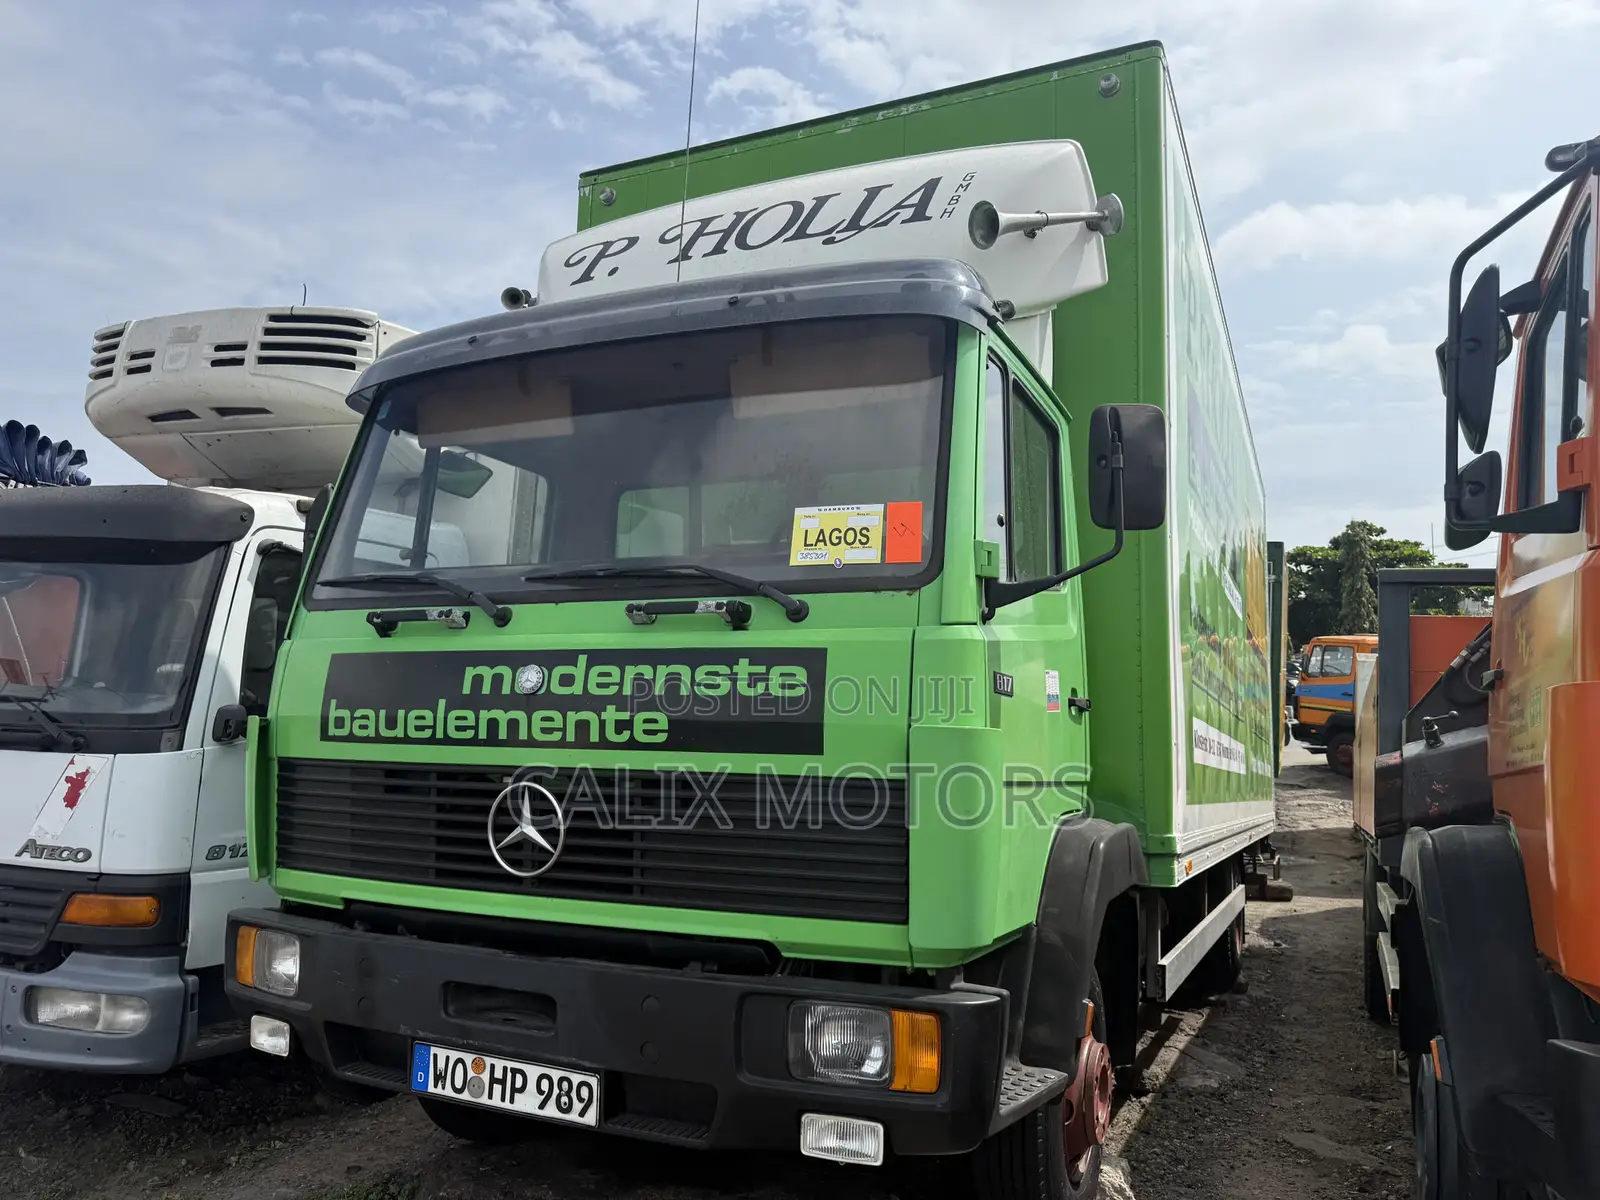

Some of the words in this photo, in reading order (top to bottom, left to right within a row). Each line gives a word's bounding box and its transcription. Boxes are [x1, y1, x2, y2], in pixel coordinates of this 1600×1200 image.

[939, 171, 977, 219] GMBH
[563, 235, 640, 287] P.
[803, 526, 871, 548] LAGOS
[996, 673, 1012, 692] 817
[326, 698, 669, 743] bauelemente
[417, 1071, 425, 1083] D
[432, 1052, 468, 1095] WO
[487, 1063, 528, 1105] HP
[535, 1073, 594, 1118] 989
